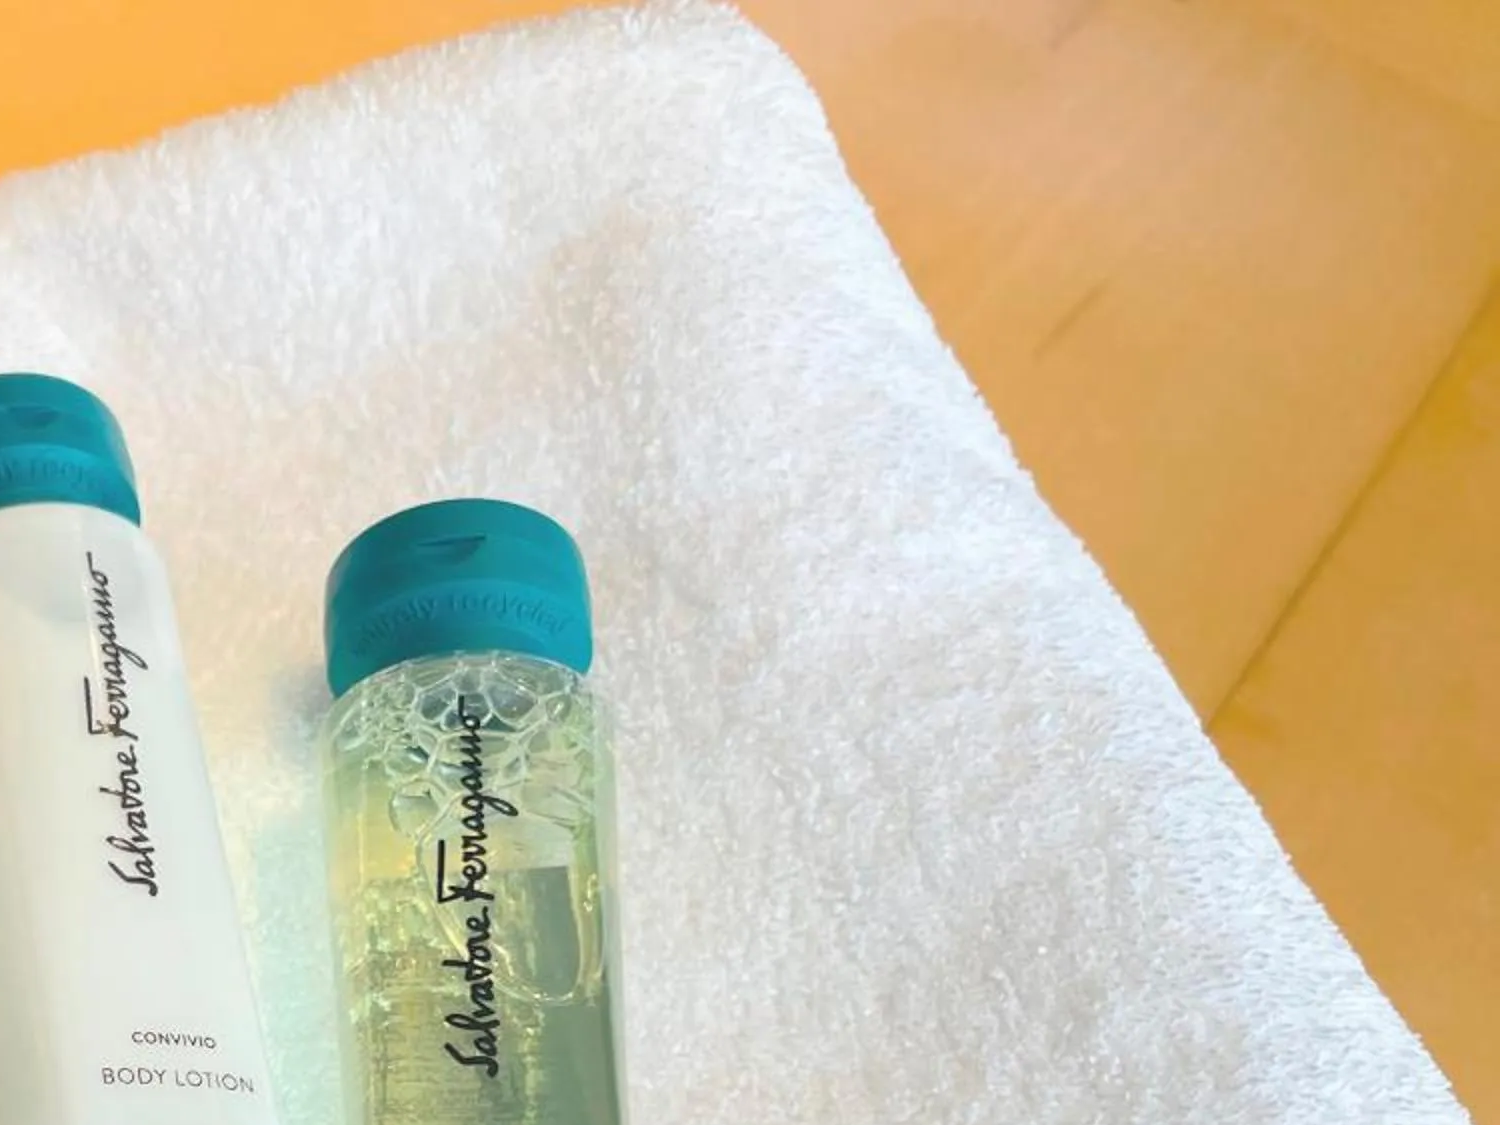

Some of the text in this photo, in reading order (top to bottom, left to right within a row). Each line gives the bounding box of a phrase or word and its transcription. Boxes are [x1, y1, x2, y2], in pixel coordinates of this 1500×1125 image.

[83, 551, 158, 897] Salvatore Ferragamo
[437, 694, 519, 903] Ferragamo
[131, 1031, 217, 1050] CONVIVIO
[442, 905, 500, 1078] Salvatore
[101, 1067, 255, 1093] BODY LOTION
